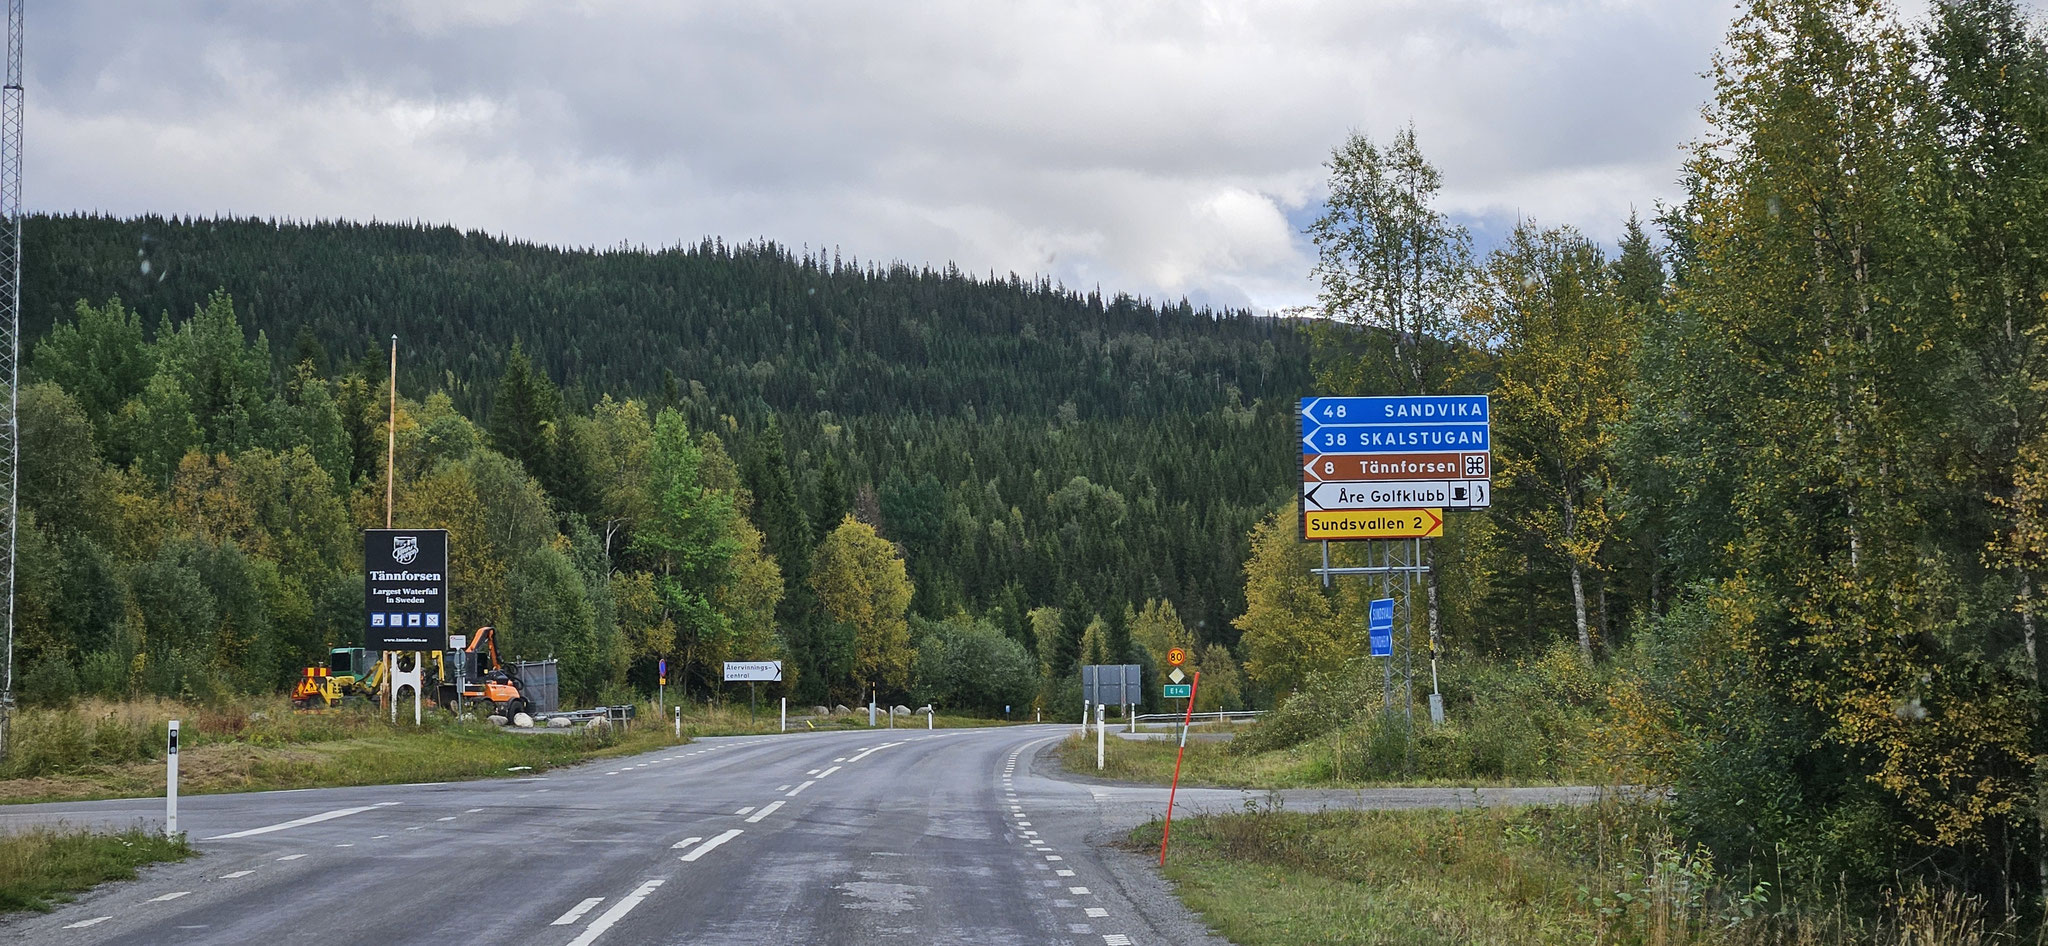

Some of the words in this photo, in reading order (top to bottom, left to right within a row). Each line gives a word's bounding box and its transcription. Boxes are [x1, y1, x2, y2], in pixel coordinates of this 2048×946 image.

[1323, 405, 1347, 418] 48
[1384, 403, 1482, 417] SANDVIKA
[1325, 433, 1347, 446] 38
[1360, 431, 1483, 446] SKALSTUGAN
[1324, 462, 1335, 475] 8
[1359, 460, 1456, 474] Tännforsen
[1338, 487, 1365, 503] Åre
[1371, 489, 1445, 503] Golfklubb
[1311, 515, 1404, 531] Sundsvallen
[1413, 517, 1423, 529] 2
[370, 571, 441, 580] Tännforsen
[373, 588, 401, 596] Largest
[1170, 653, 1183, 661] 80
[1170, 687, 1184, 695] E14
